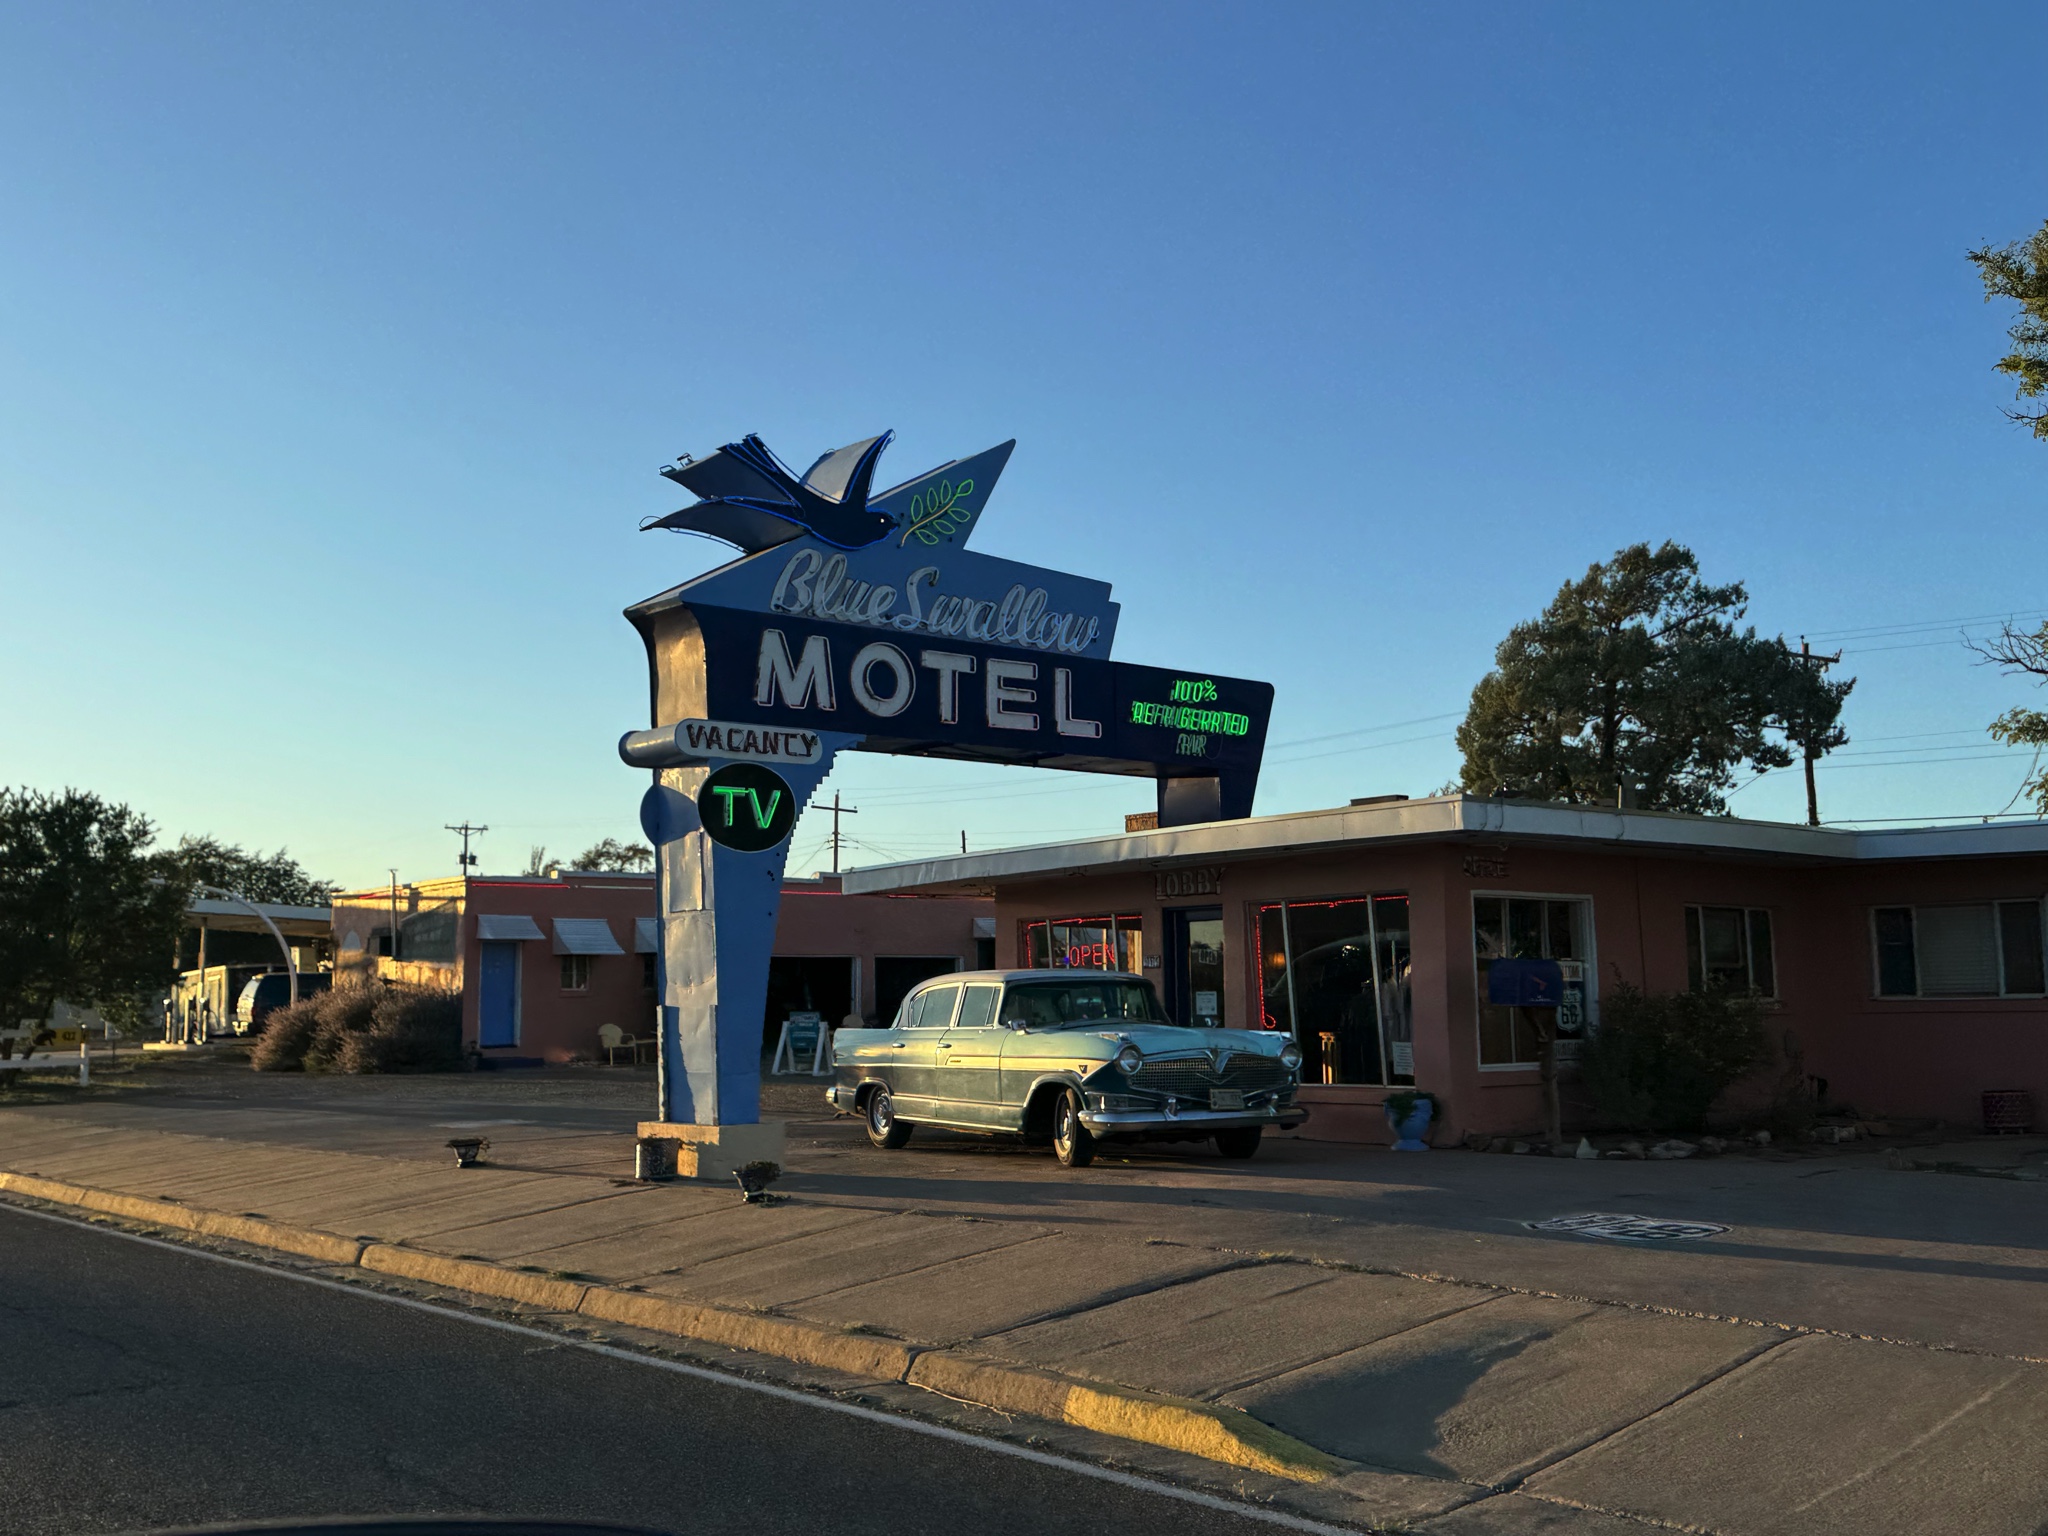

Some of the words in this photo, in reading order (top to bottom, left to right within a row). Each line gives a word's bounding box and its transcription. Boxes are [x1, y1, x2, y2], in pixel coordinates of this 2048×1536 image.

[770, 548, 897, 624] Blue
[892, 566, 1099, 653] Swallow
[755, 629, 1101, 738] MOTEL
[1170, 679, 1218, 703] 100%
[1130, 700, 1249, 736] REFRIGERATED
[686, 723, 818, 757] VACANCY
[713, 785, 781, 829] TV
[1155, 867, 1226, 901] LOBBY
[1070, 941, 1117, 967] OPEN
[1200, 949, 1216, 963] OPEN
[1562, 1005, 1579, 1024] 66
